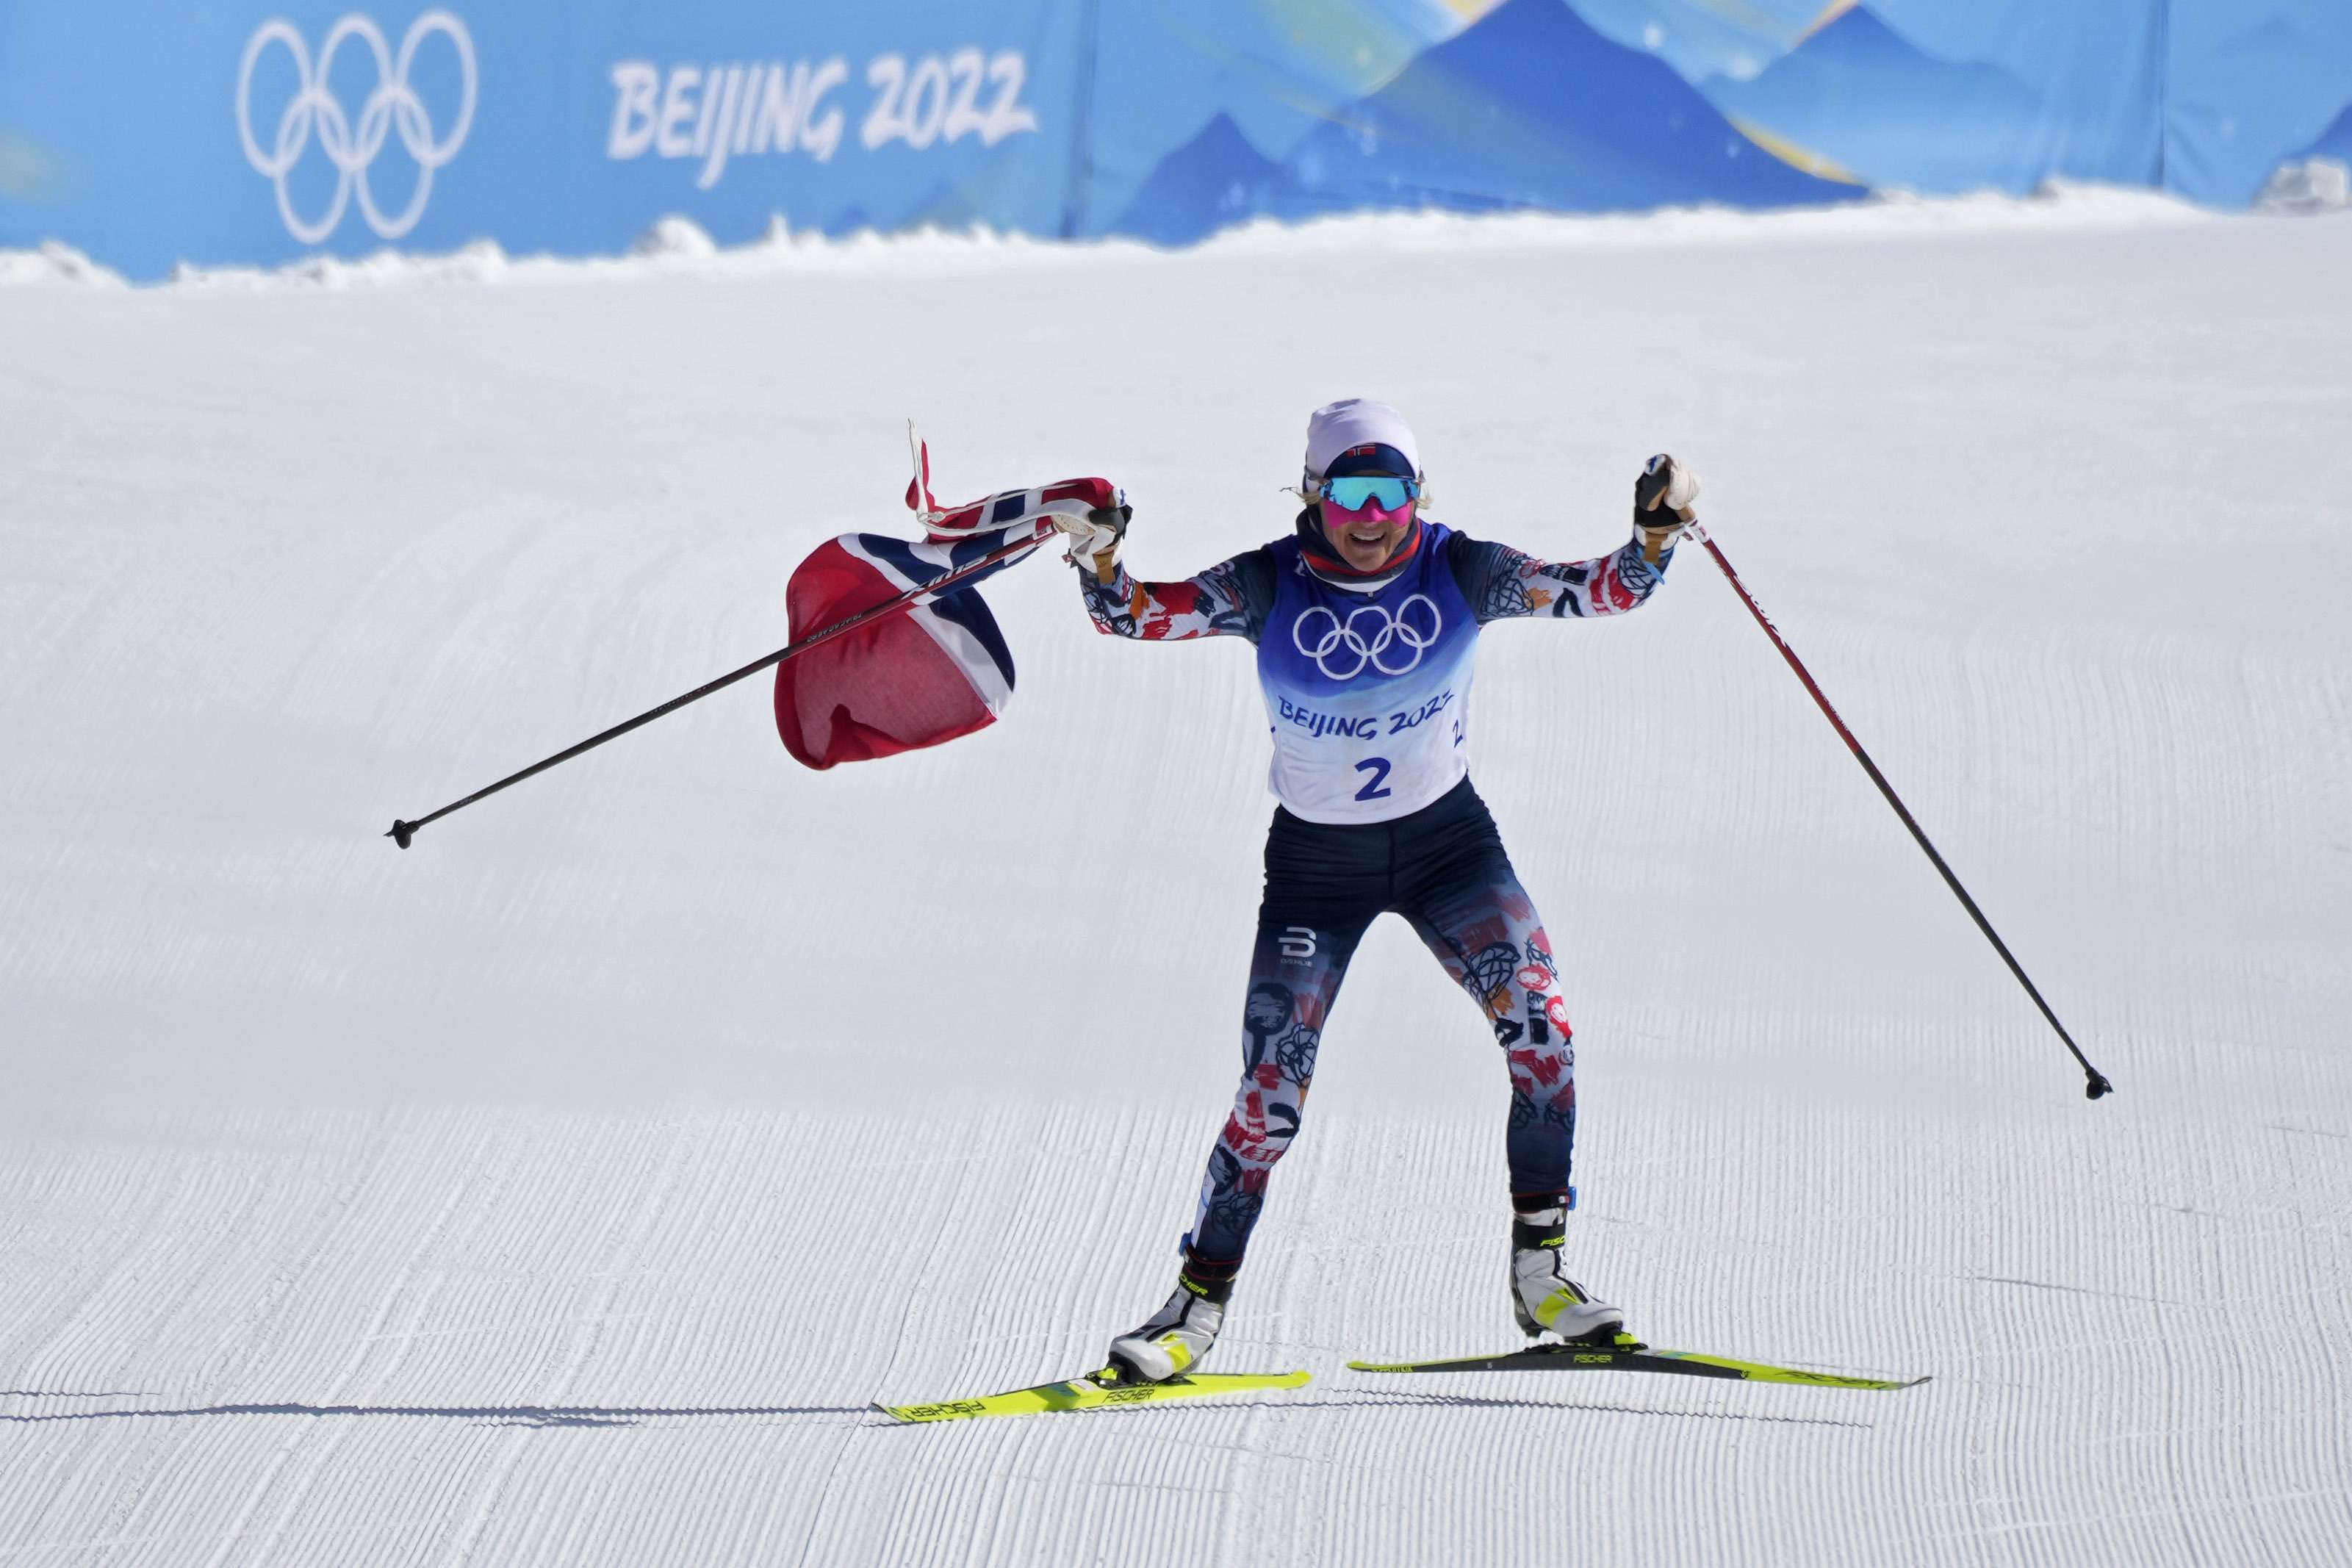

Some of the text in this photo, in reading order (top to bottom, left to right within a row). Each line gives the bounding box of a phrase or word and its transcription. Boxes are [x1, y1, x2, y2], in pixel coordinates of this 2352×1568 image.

[607, 48, 1037, 190] BEIJING 2022
[1279, 695, 1378, 741] BEIJING
[1354, 757, 1391, 802] 2
[905, 1400, 986, 1417] FISCHER
[1102, 1389, 1154, 1403] FISCHER
